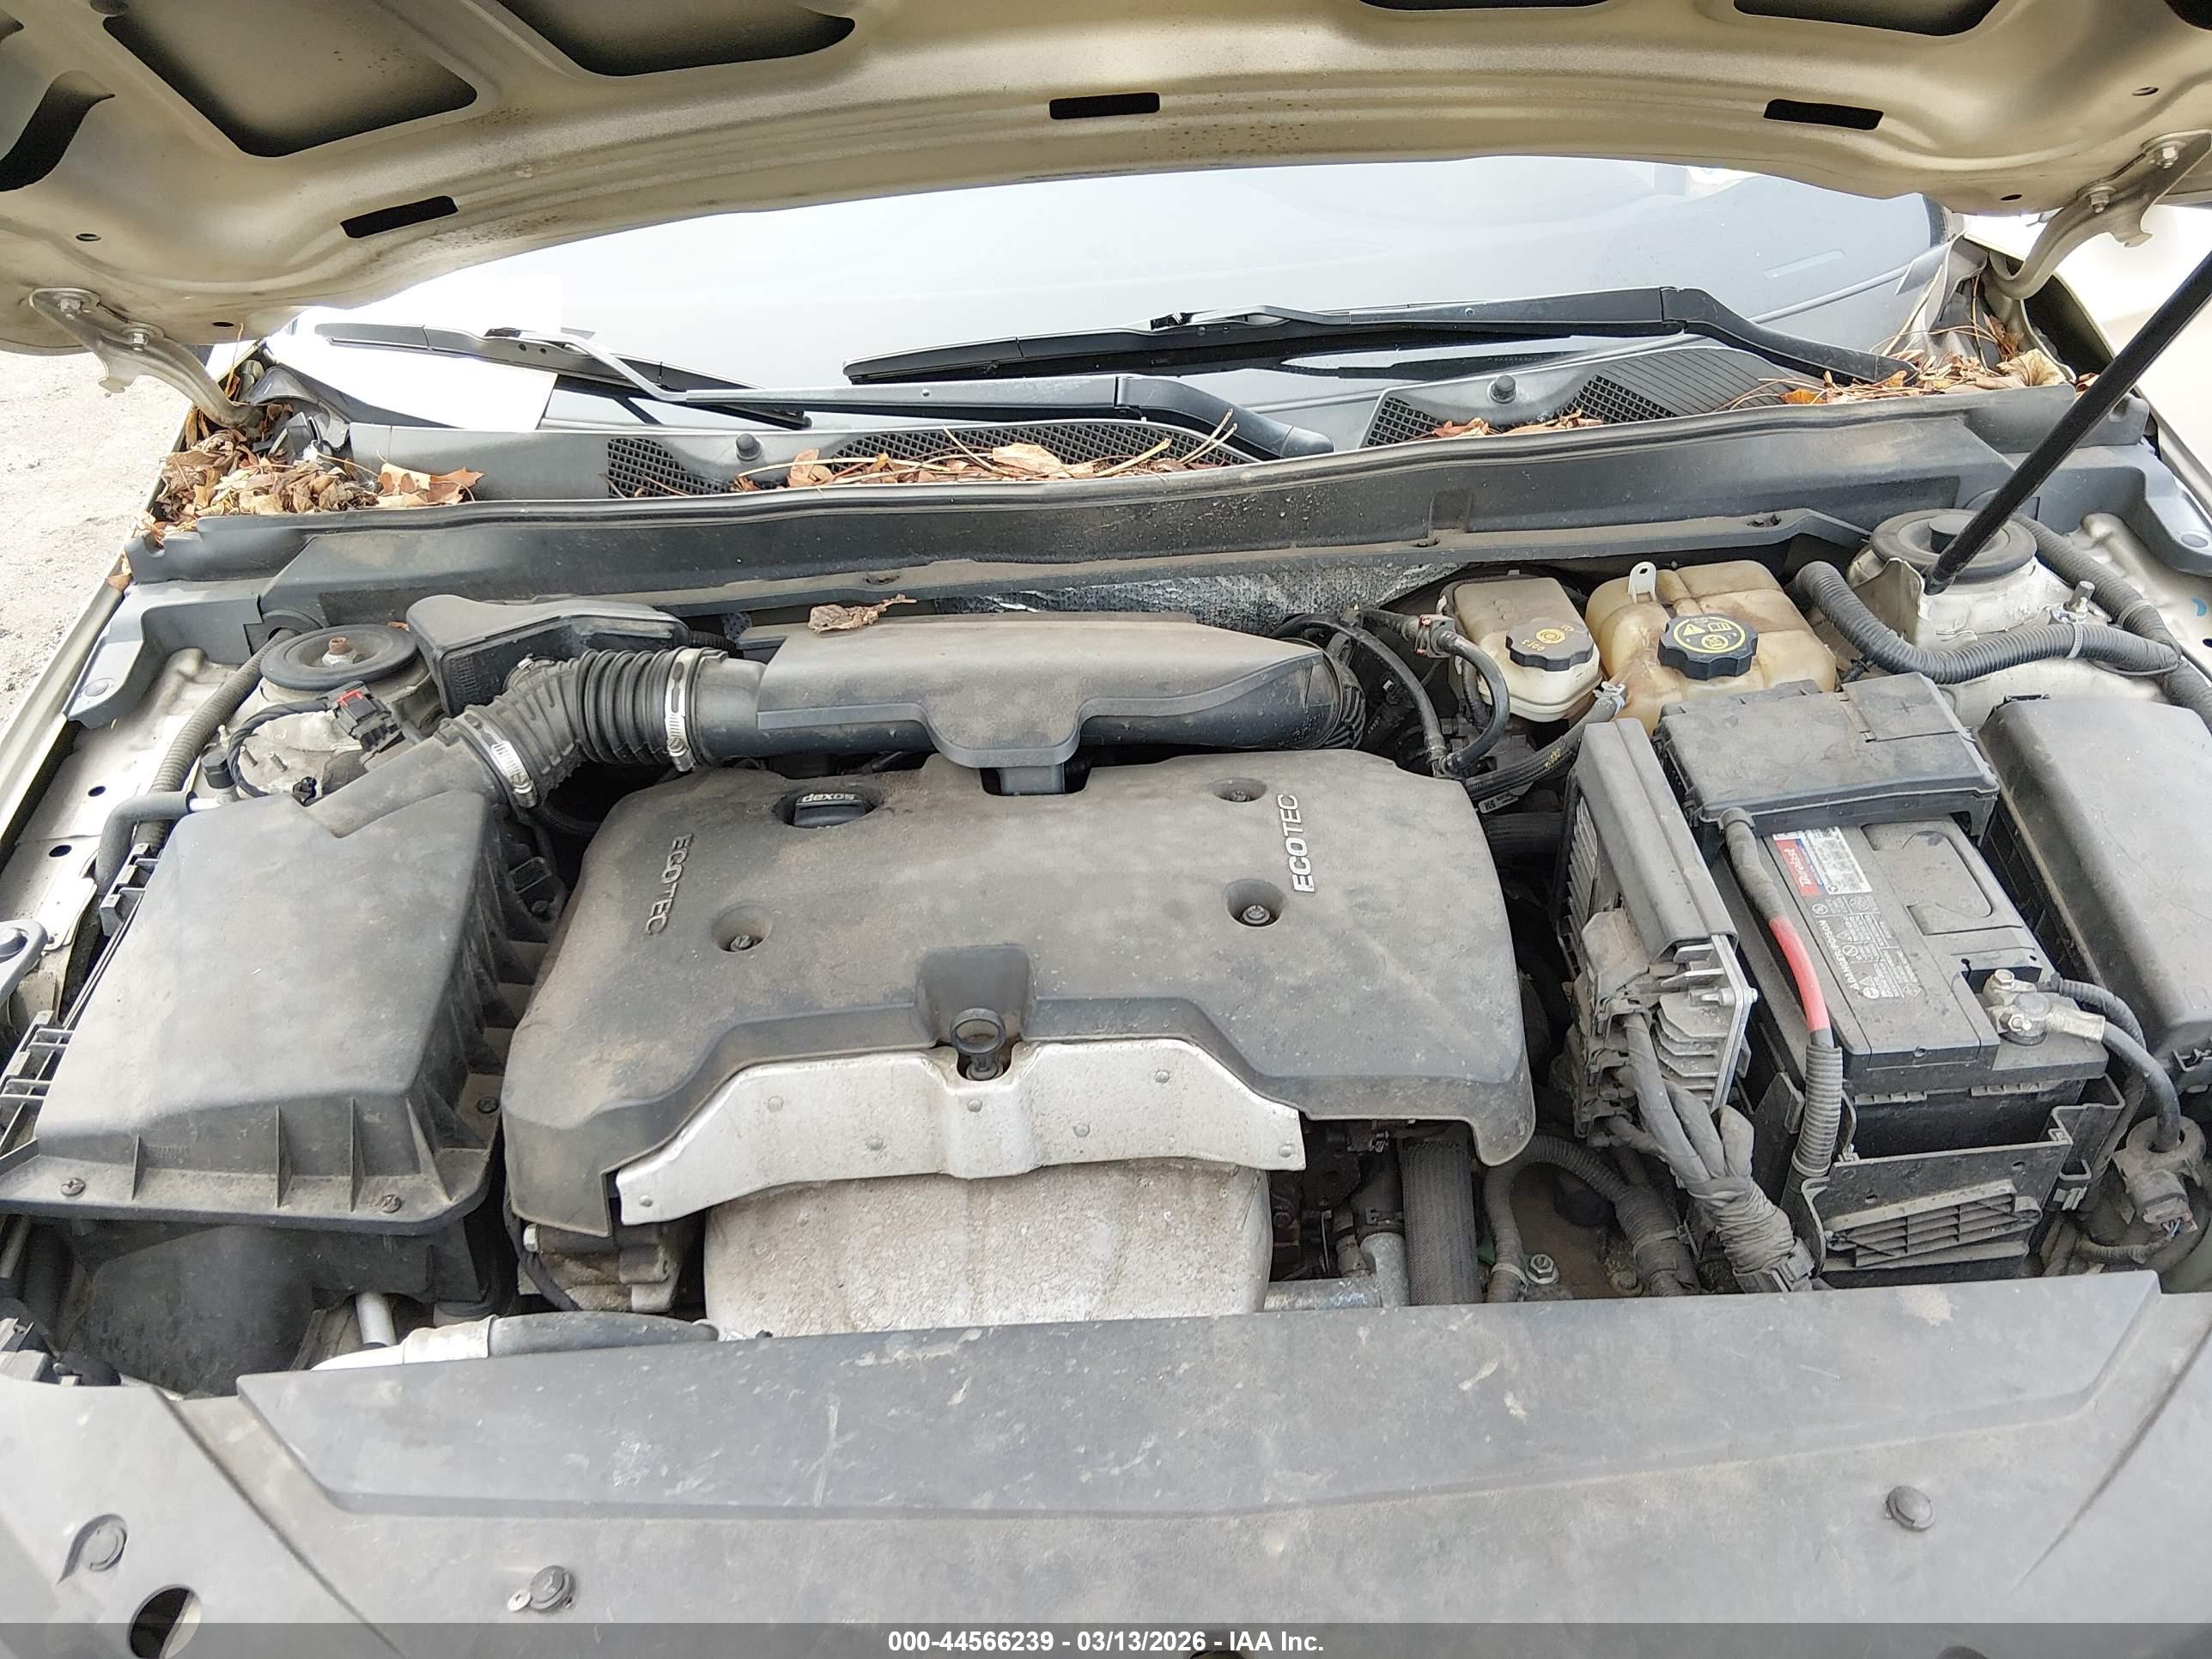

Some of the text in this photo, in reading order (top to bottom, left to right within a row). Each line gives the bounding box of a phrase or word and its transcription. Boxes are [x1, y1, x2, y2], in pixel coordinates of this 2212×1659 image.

[802, 793, 855, 803] dexos
[1277, 793, 1316, 893] ECOTEC
[1784, 848, 1812, 887] Duralast
[646, 833, 694, 936] ECOTEC
